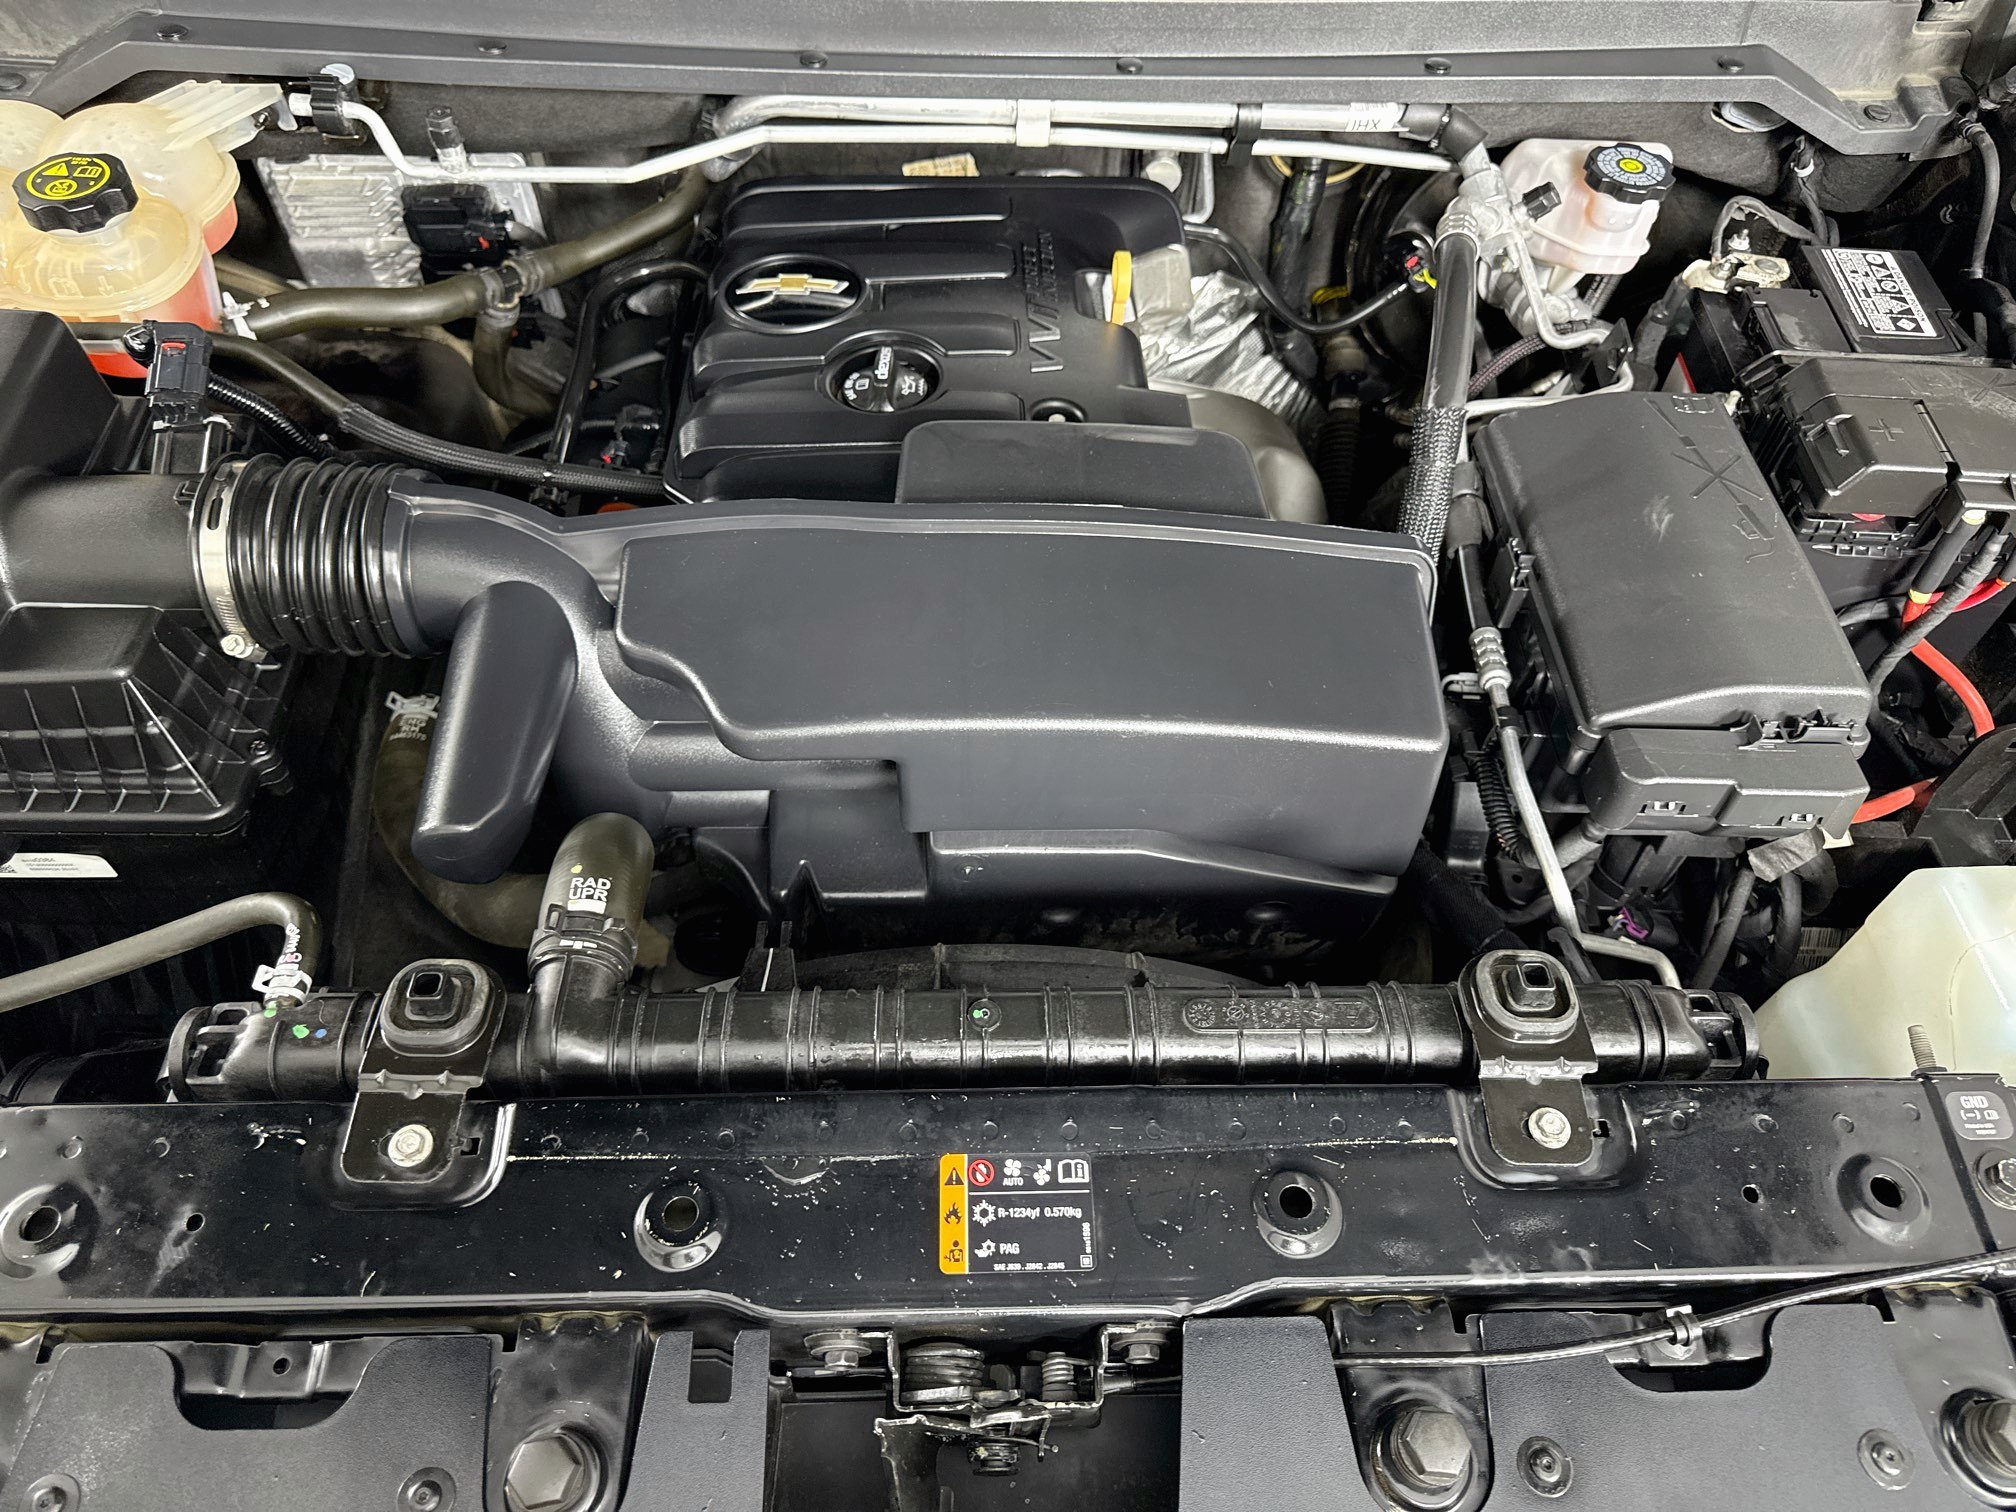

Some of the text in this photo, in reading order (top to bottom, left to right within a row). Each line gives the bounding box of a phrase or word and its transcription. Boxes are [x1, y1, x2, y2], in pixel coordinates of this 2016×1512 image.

[874, 346, 893, 380] dexos
[571, 877, 612, 890] RAD
[569, 888, 608, 902] UPR
[1960, 1095, 1989, 1109] GND
[1002, 1176, 1024, 1187] AUTO
[997, 1206, 1083, 1220] R-1234yf 0.570kg
[999, 1242, 1020, 1255] PAG
